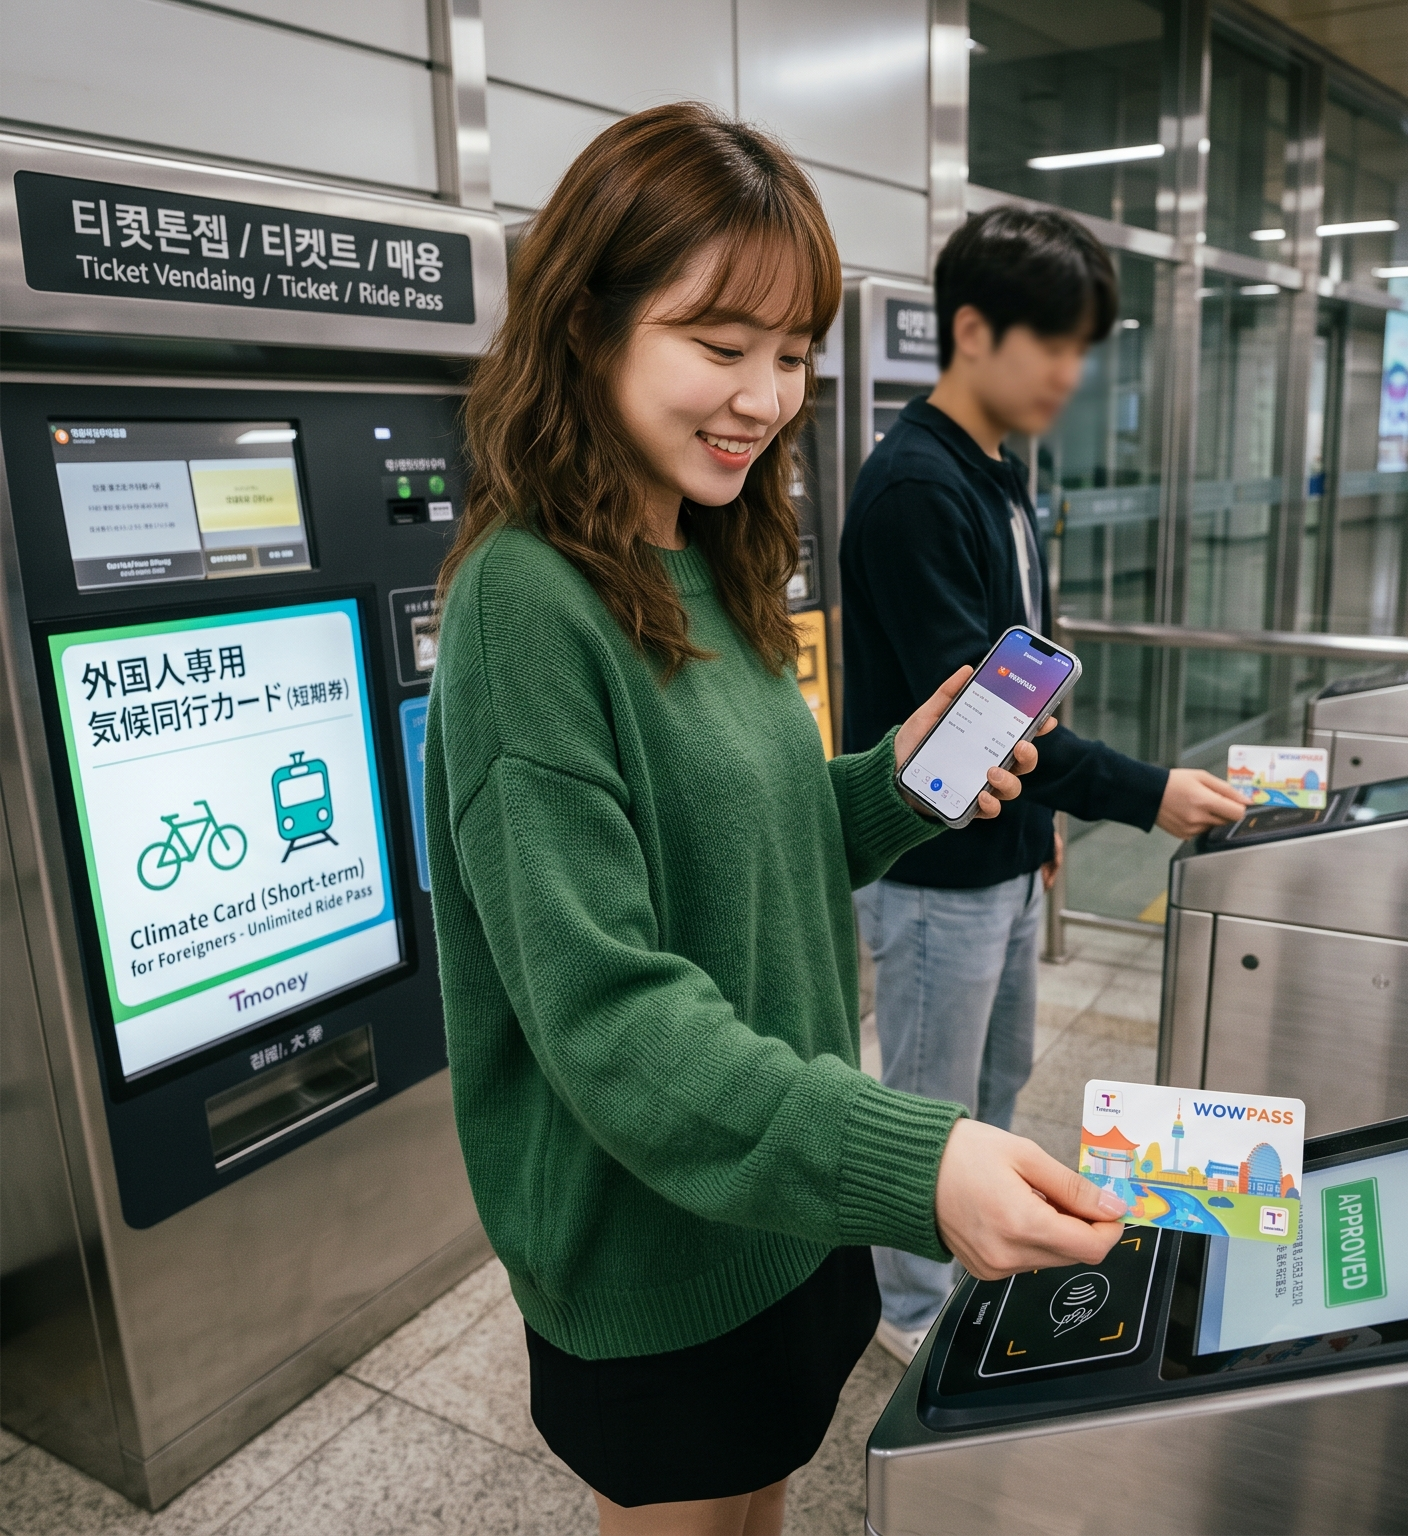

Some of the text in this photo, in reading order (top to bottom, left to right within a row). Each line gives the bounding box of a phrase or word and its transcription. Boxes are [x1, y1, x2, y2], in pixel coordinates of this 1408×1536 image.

[76, 255, 149, 285] Ticket
[153, 264, 255, 299] Vendaing
[277, 275, 338, 301] Ticket
[359, 284, 400, 307] Ride
[405, 288, 443, 311] Pass
[261, 223, 360, 270] 티켓트
[386, 240, 443, 283] 매용
[81, 645, 246, 700] 外国人専用
[88, 683, 282, 747] 気候同行カード
[130, 857, 365, 951] Climate Card (Short-term)
[131, 960, 154, 977] for
[158, 932, 237, 968] Foreigners
[248, 908, 313, 937] Unlimited
[316, 896, 344, 914] Ride
[346, 885, 373, 906] Pass
[229, 971, 308, 1012] Tmoney
[1193, 1102, 1294, 1125] WOWPASS
[1338, 1193, 1368, 1291] APPROVED
